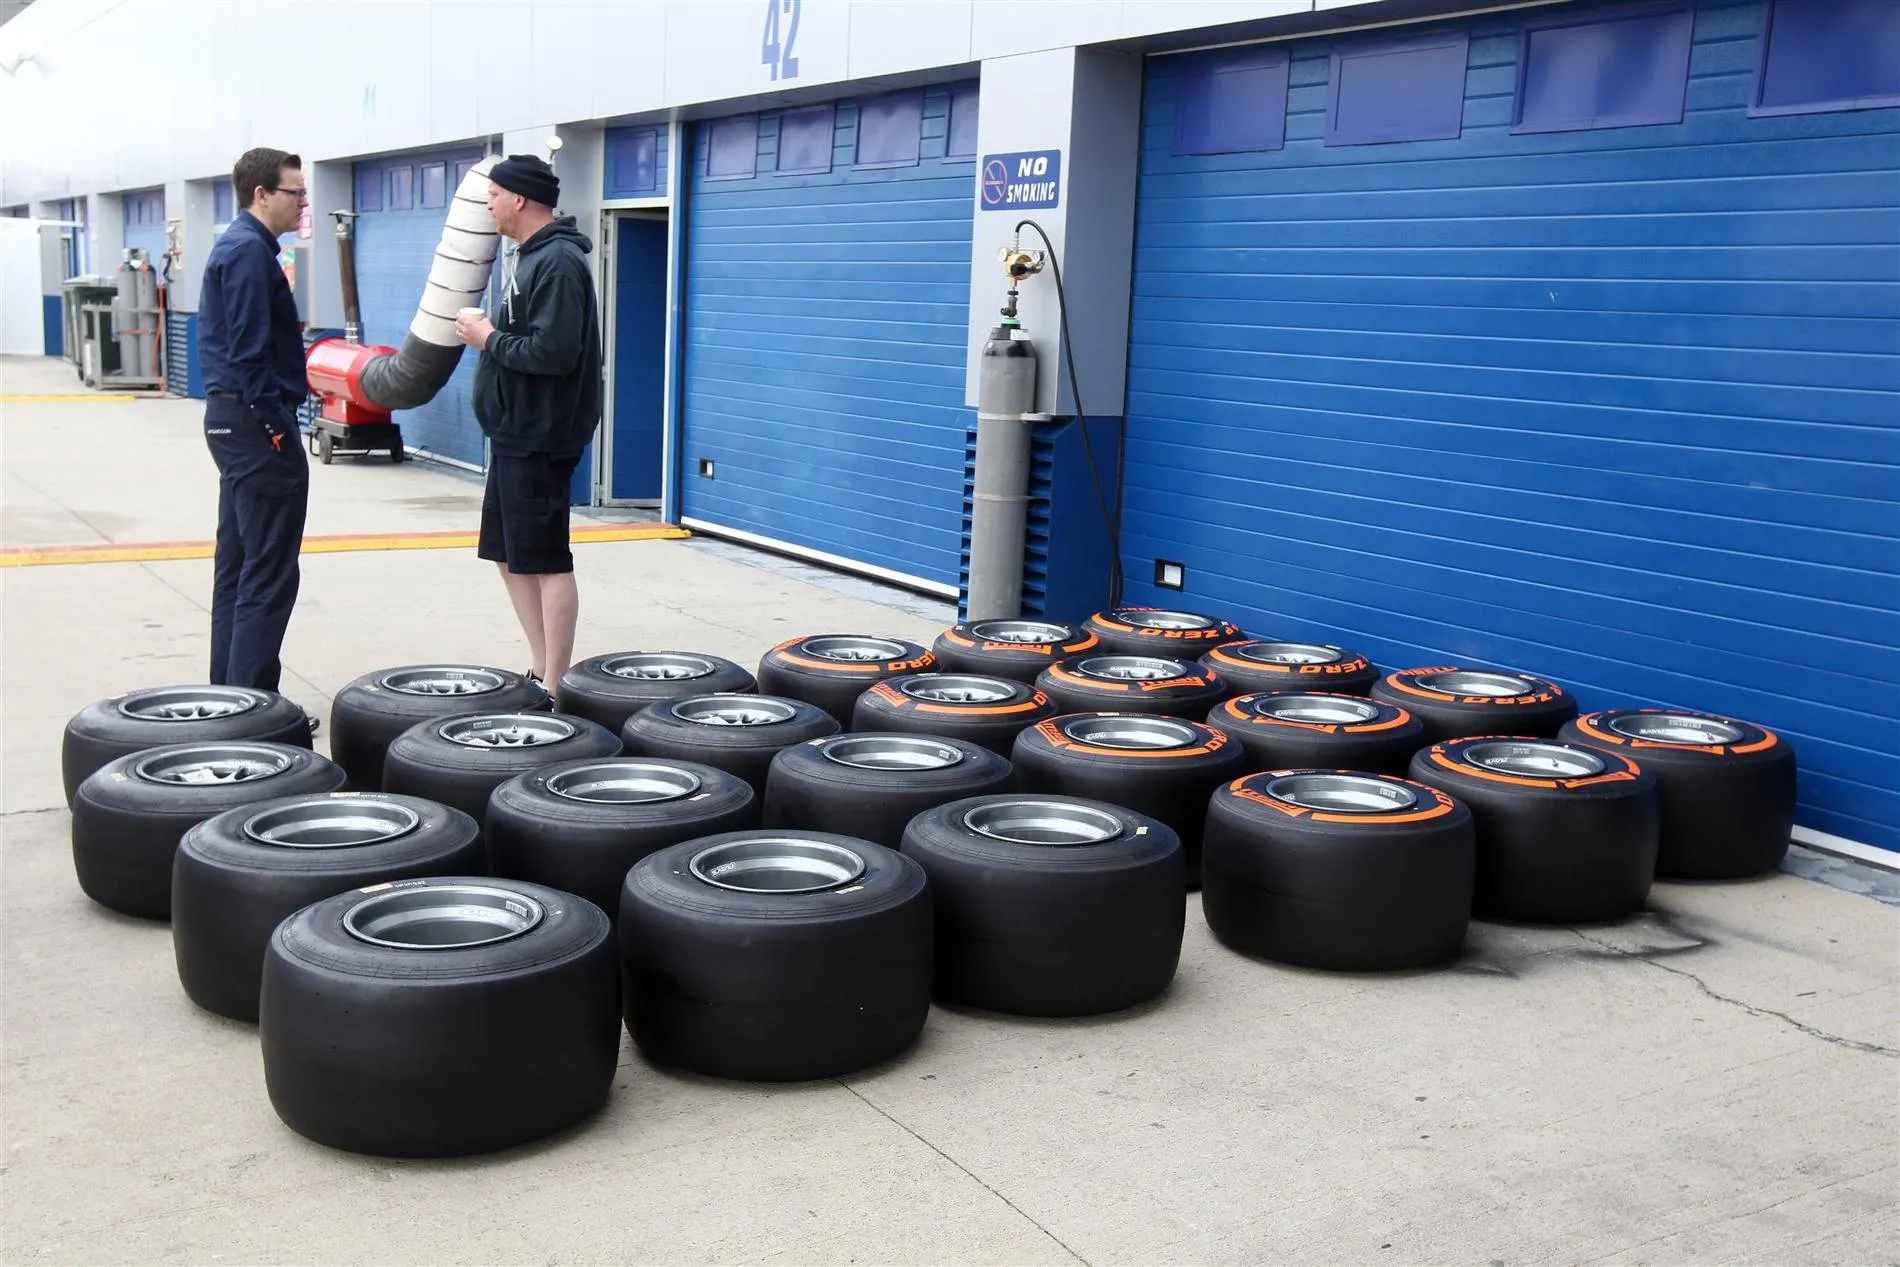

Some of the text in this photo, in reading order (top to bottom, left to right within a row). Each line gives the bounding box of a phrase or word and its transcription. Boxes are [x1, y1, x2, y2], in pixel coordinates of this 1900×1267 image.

[762, 0, 801, 81] 42
[1018, 157, 1049, 177] NO
[1006, 182, 1056, 203] SMOKING
[1138, 629, 1220, 640] ZERO
[1298, 659, 1368, 674] ZERO
[1462, 693, 1553, 706] ZERO
